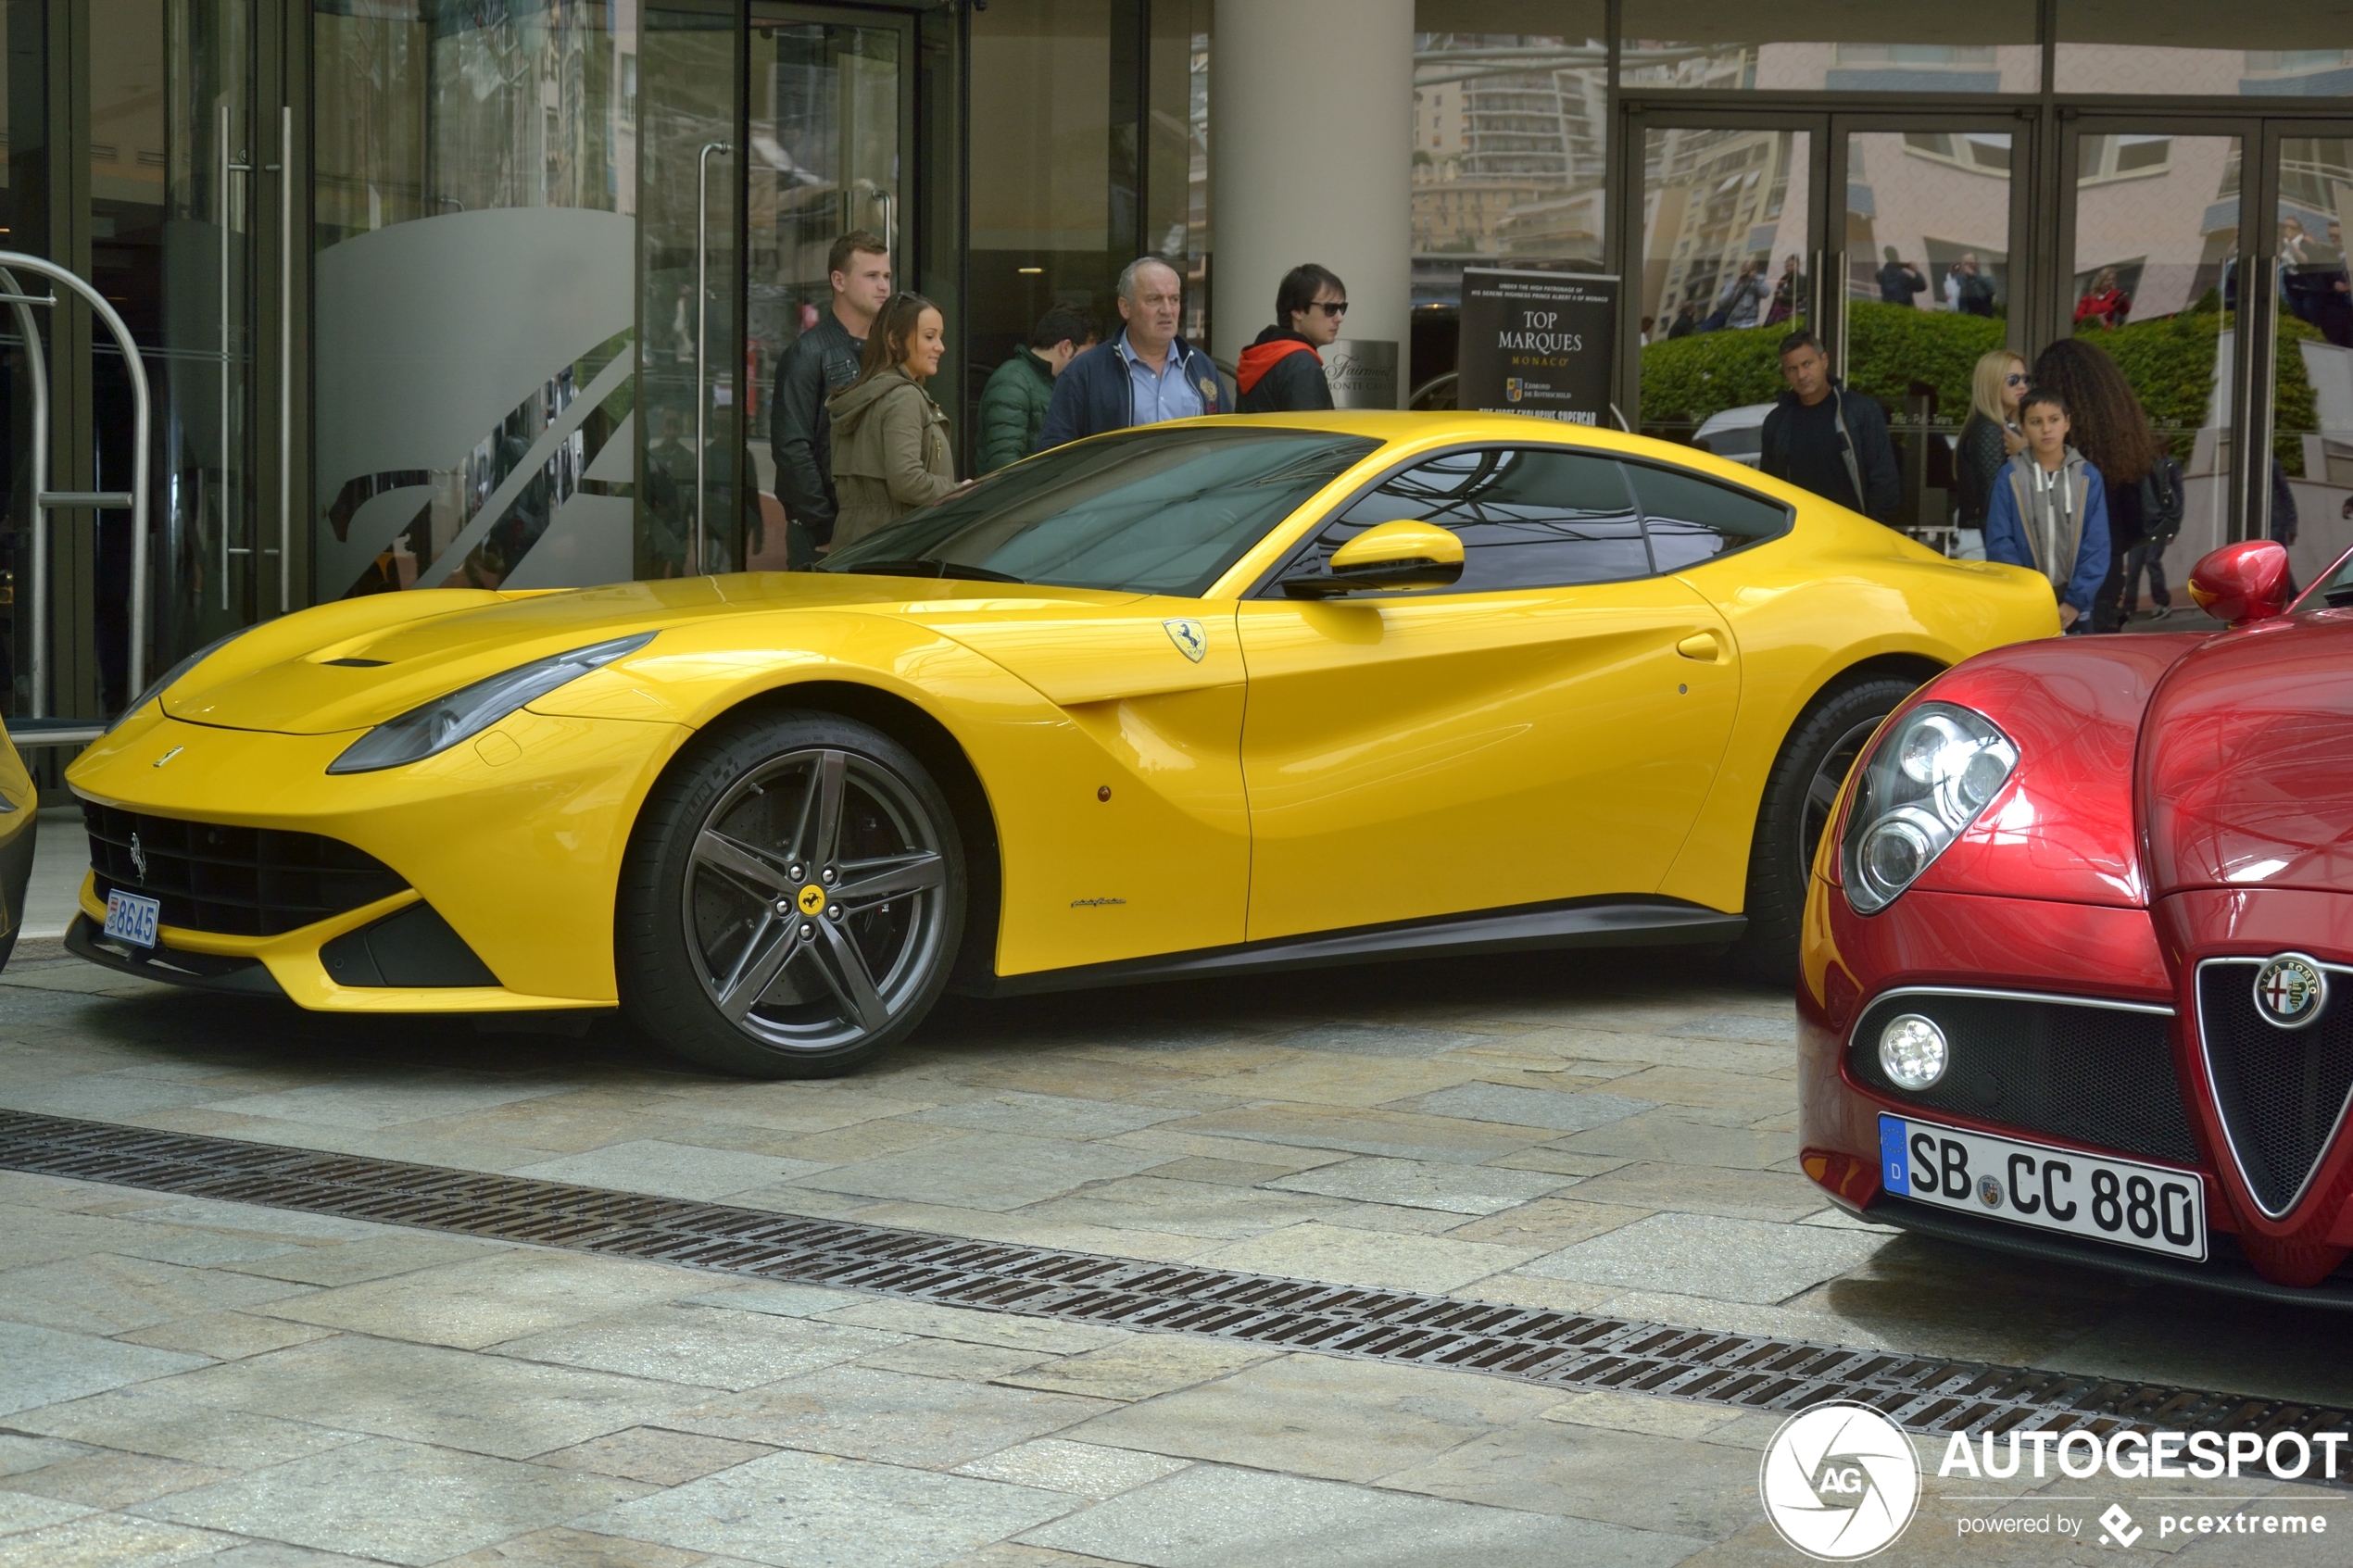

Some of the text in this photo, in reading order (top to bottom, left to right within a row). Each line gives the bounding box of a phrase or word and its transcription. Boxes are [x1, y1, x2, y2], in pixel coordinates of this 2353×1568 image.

[1531, 292, 1551, 300] PRINCE
[1544, 284, 1575, 293] PATRONAGE
[1523, 311, 1557, 329] TOP
[1498, 332, 1582, 355] MARQUES
[1324, 353, 1395, 381] Fairmont
[1512, 357, 1568, 366] MONACO
[117, 899, 155, 941] 8645
[2259, 961, 2317, 995] ALFA ROMEO
[1892, 1162, 1901, 1180] D
[1910, 1132, 1972, 1200] SB
[2007, 1152, 2077, 1222] CC
[2091, 1168, 2195, 1247] 880
